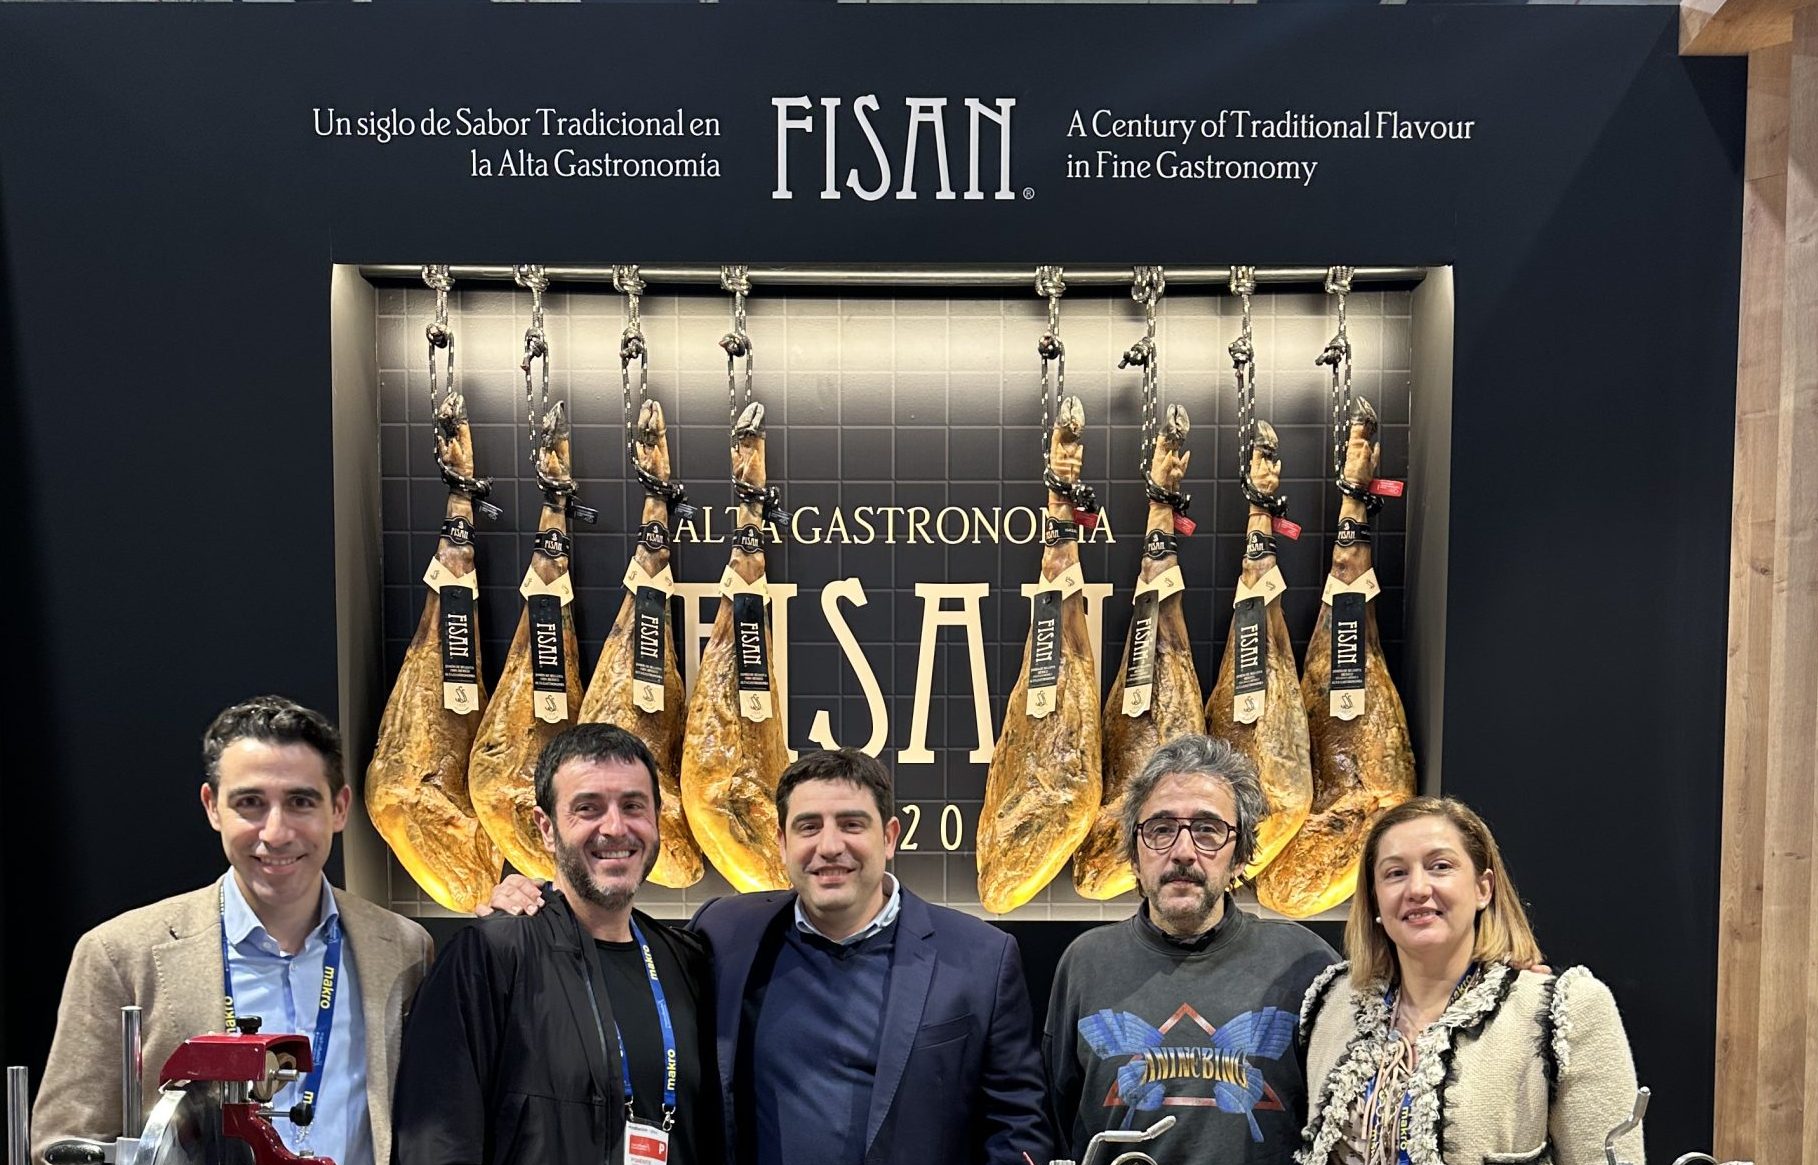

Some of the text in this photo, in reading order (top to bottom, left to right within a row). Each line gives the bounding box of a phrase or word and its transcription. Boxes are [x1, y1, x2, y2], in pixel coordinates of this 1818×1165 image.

[312, 107, 721, 143] Un siglo de Sabor Tradicional en
[1067, 110, 1475, 144] A Century of Traditional Flavour
[471, 149, 721, 178] la Alta Gastronomía
[771, 94, 1016, 201] FISAN
[1067, 151, 1318, 186] in Fine Gastronomy
[792, 505, 1117, 544] GASTRONOA
[448, 613, 469, 657] FISAN
[536, 622, 558, 666] FISAN
[640, 614, 659, 659] FISAN
[740, 621, 762, 665] FISAN
[1036, 618, 1055, 663] FISAN
[1133, 617, 1152, 661] FISAN
[1240, 623, 1258, 668] FISAN
[1338, 621, 1358, 664] FISAN
[899, 804, 964, 851] 20
[643, 945, 659, 981] makro
[320, 966, 335, 1009] makro
[666, 1049, 677, 1091] makro
